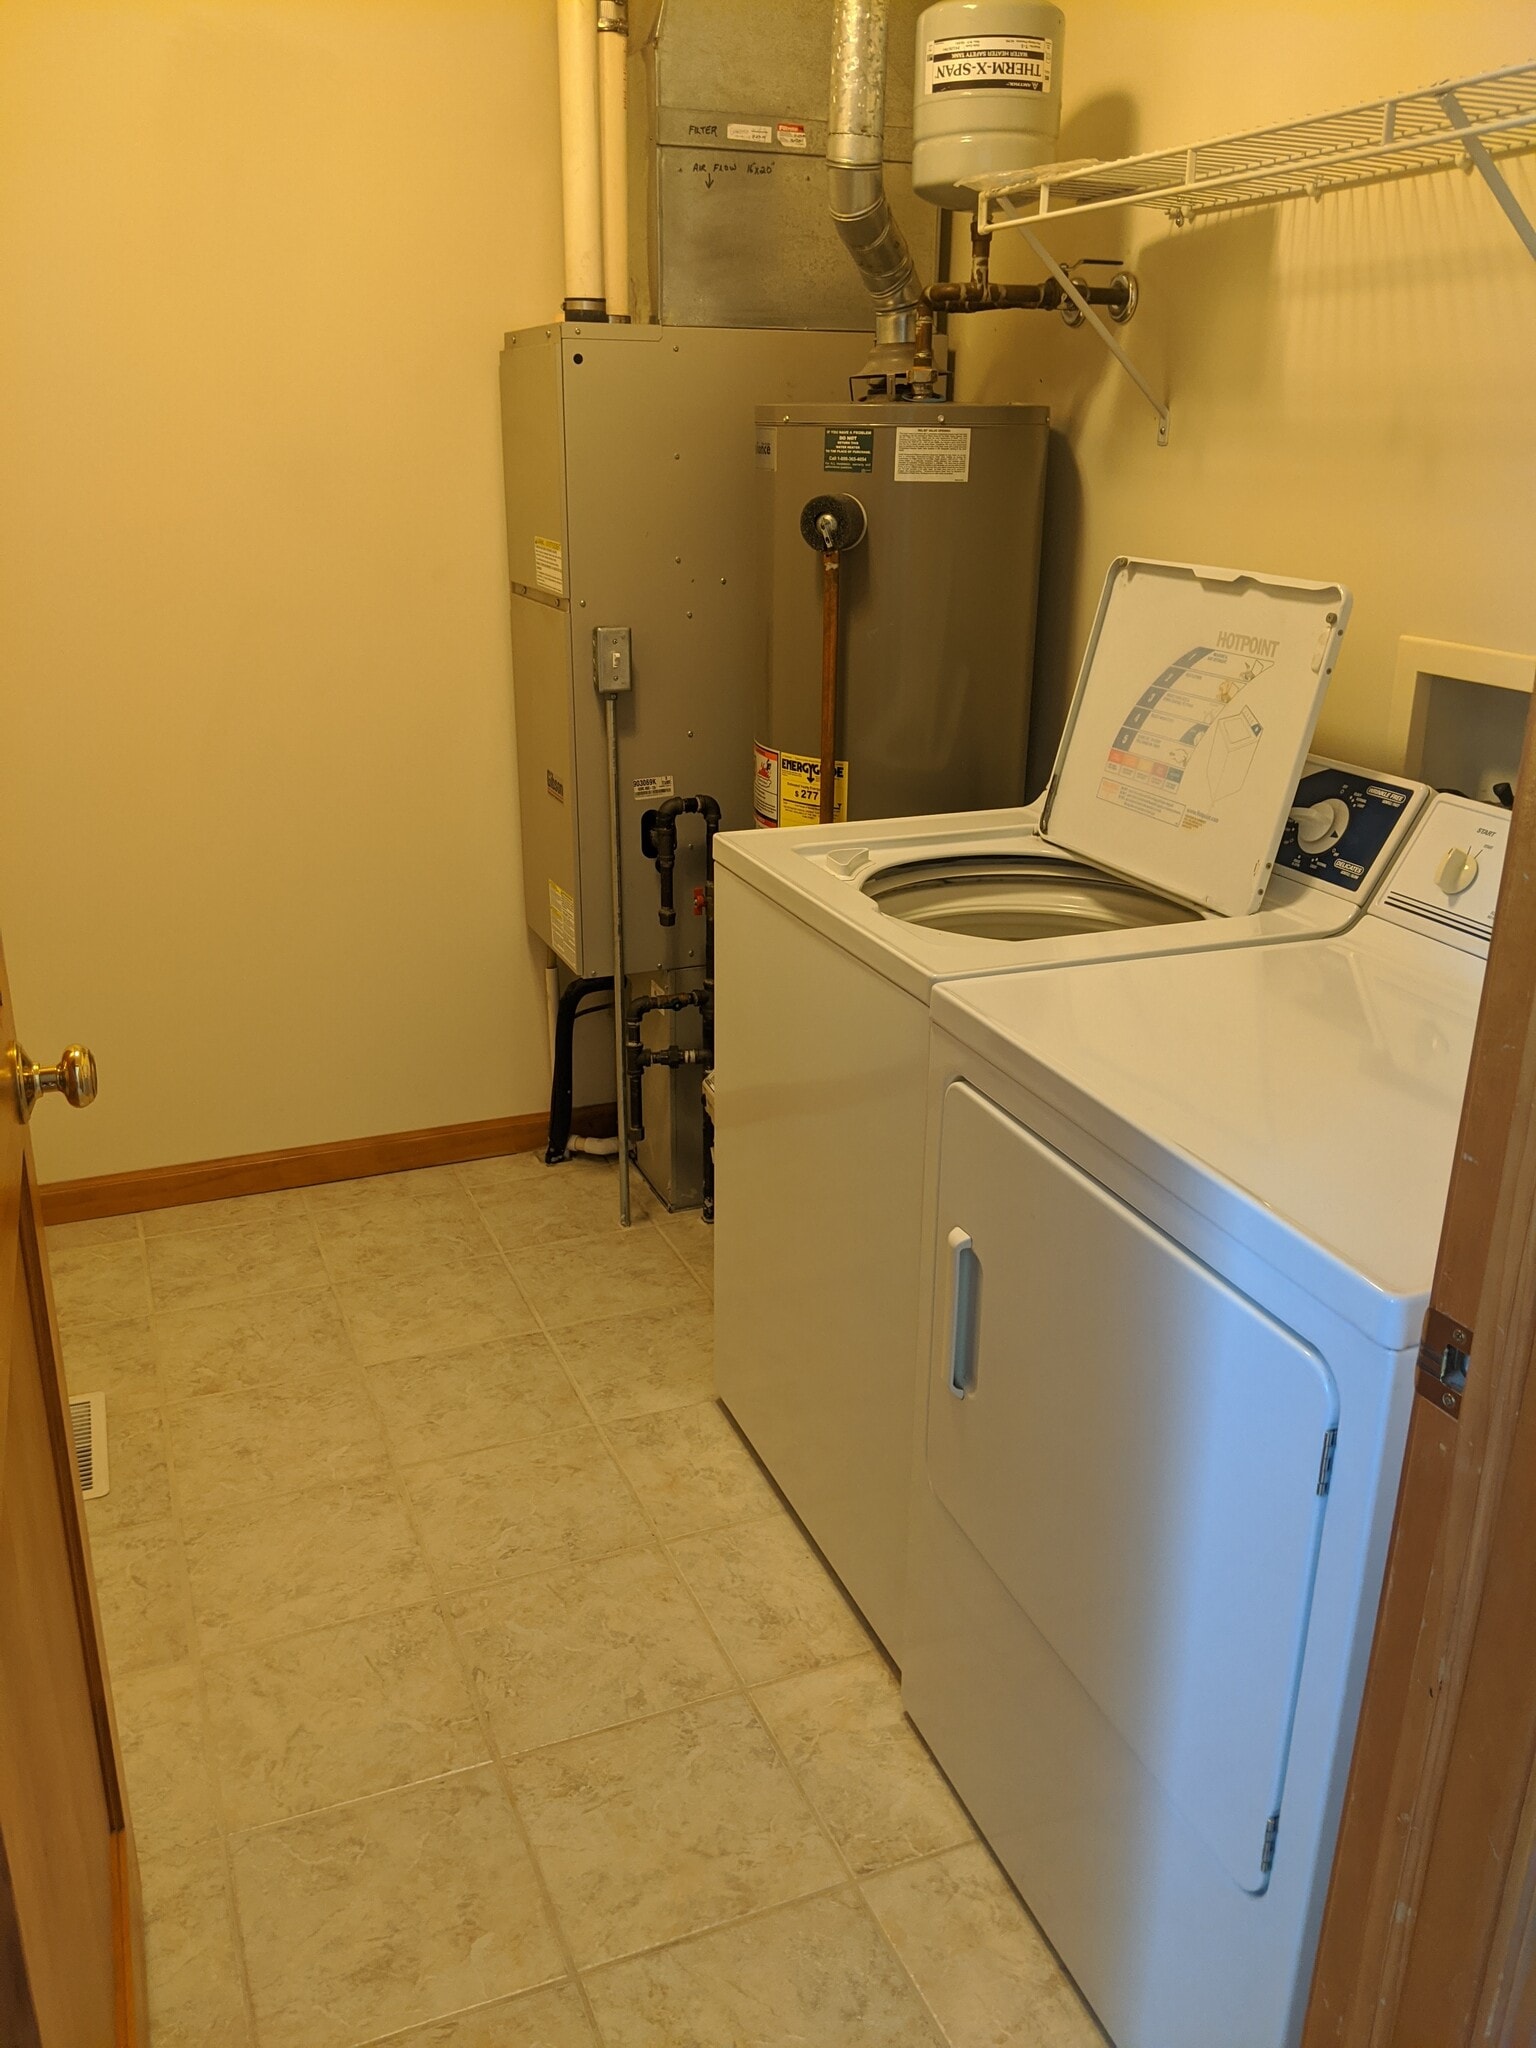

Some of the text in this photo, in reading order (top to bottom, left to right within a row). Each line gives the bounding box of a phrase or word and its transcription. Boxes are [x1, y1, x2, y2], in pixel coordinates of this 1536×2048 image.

[936, 61, 1041, 78] THERM-X-SPAN
[688, 125, 718, 137] FILTER
[692, 163, 707, 172] AIR
[712, 163, 737, 172] FLOW
[1216, 630, 1281, 658] HOTPOINT
[800, 789, 819, 800] 277
[1368, 787, 1404, 801] WRINKLE FREE
[1476, 827, 1497, 838] START
[1335, 859, 1363, 874] DELICATES
